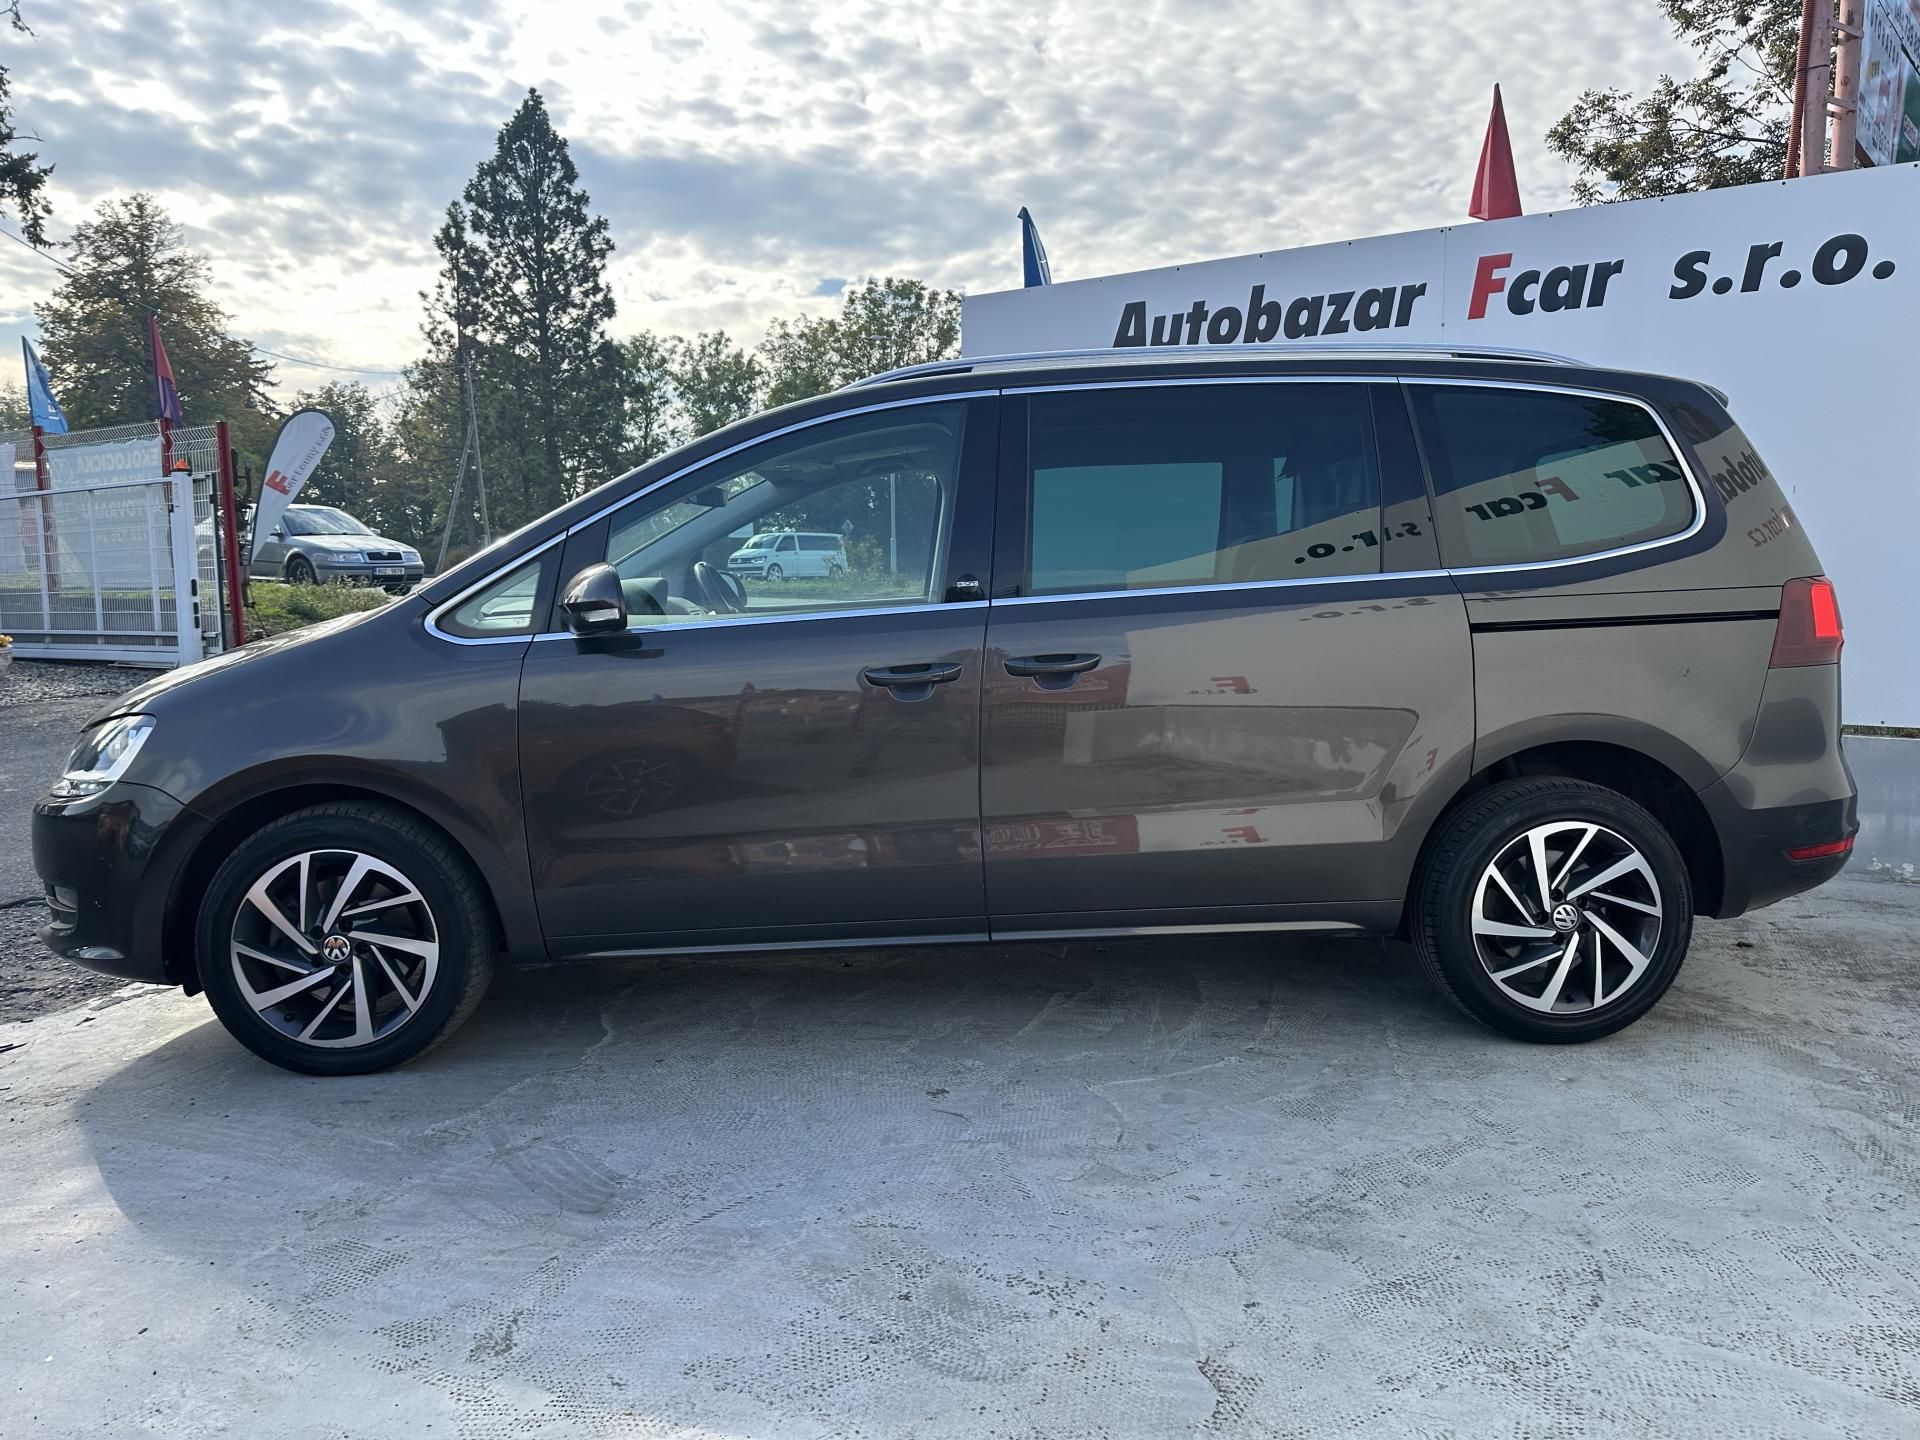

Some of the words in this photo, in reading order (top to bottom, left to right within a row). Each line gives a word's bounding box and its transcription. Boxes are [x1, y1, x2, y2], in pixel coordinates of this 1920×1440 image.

[1112, 282, 1427, 348] Autobazar
[1467, 252, 1625, 320] Fcar
[1668, 233, 1896, 300] s.r.o.
